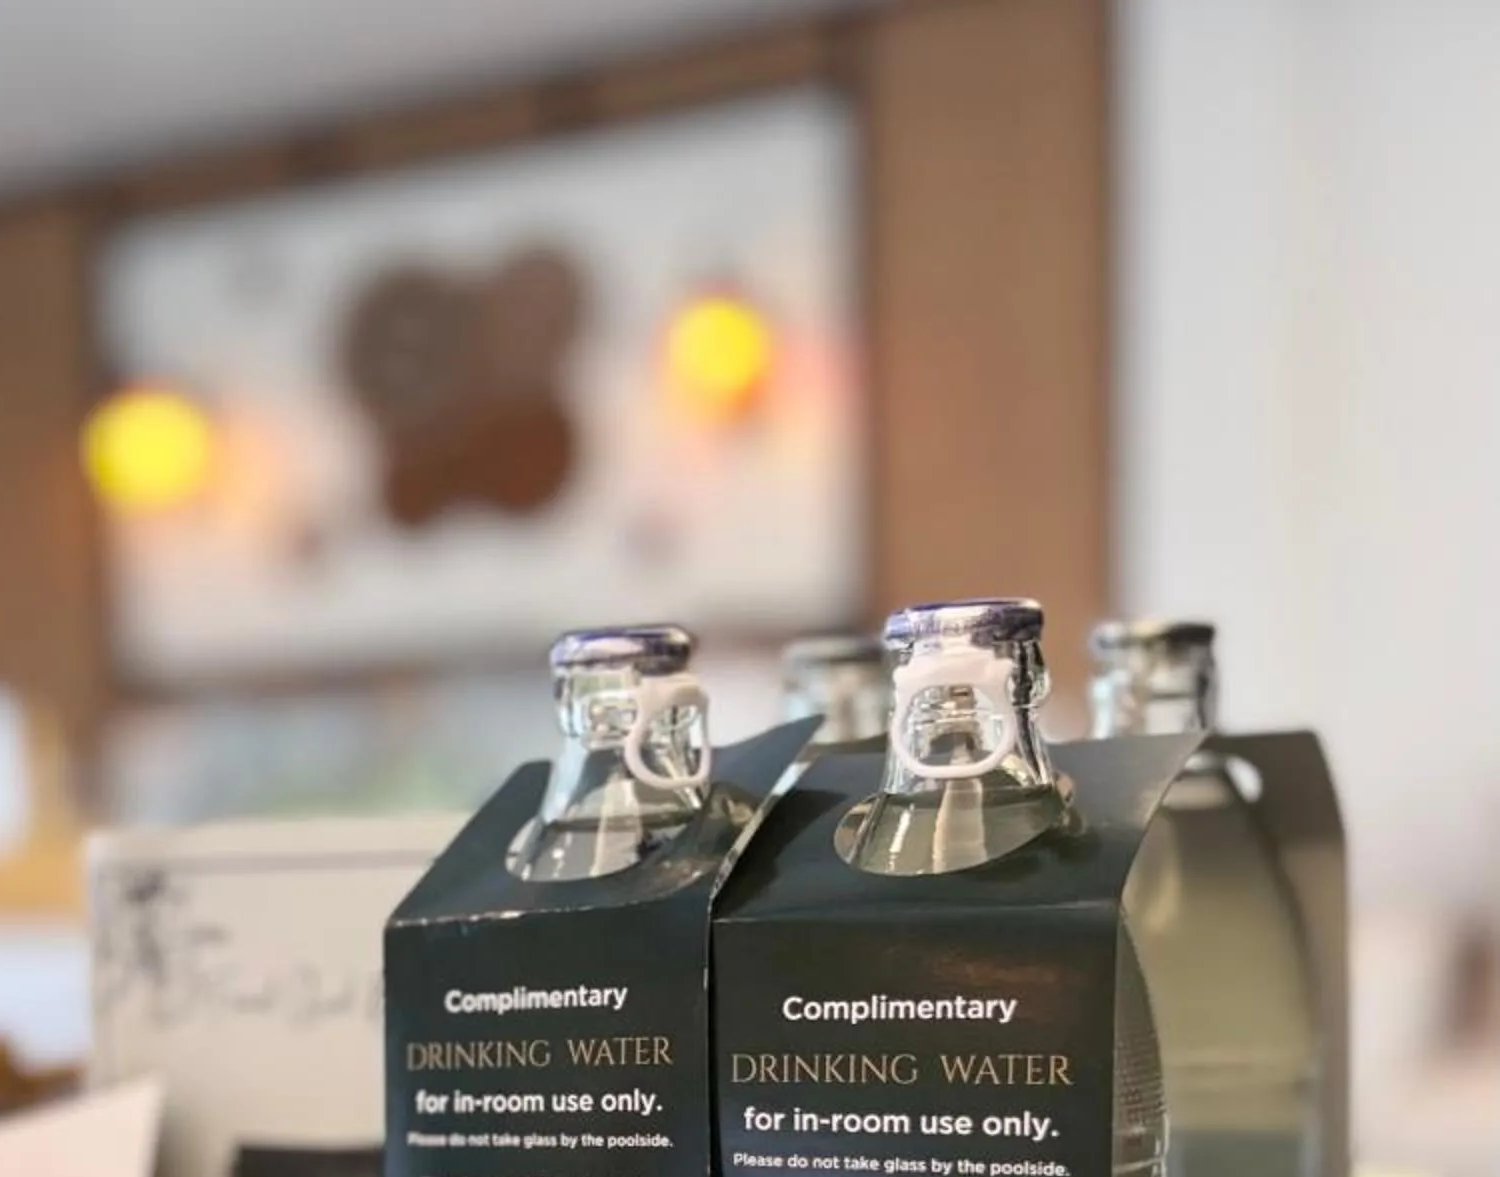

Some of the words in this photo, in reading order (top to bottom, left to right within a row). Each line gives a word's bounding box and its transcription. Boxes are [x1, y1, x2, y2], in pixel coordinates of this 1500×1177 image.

[444, 985, 628, 1014] Complimentary
[782, 995, 1016, 1025] Complimentary
[407, 1039, 550, 1071] DRINKING
[567, 1037, 674, 1066] WATER
[731, 1053, 919, 1085] DRINKING
[940, 1054, 1073, 1086] WATER
[415, 1090, 450, 1114] for
[453, 1090, 545, 1113] in-room
[553, 1093, 594, 1112] use
[602, 1089, 663, 1116] only.
[744, 1107, 785, 1131] for
[793, 1108, 909, 1134] in-room
[920, 1115, 973, 1135] use
[982, 1111, 1059, 1141] only.
[492, 1132, 520, 1147] take
[523, 1132, 557, 1149] glass
[560, 1132, 578, 1149] by
[581, 1132, 604, 1147] the
[607, 1132, 674, 1149] poolside.
[733, 1152, 783, 1168] Please
[787, 1153, 808, 1168] do
[812, 1155, 840, 1169] not
[844, 1155, 879, 1170] take
[883, 1157, 927, 1174] glass
[931, 1158, 952, 1176] by
[957, 1159, 985, 1174] the
[990, 1160, 1071, 1177] poolside.
